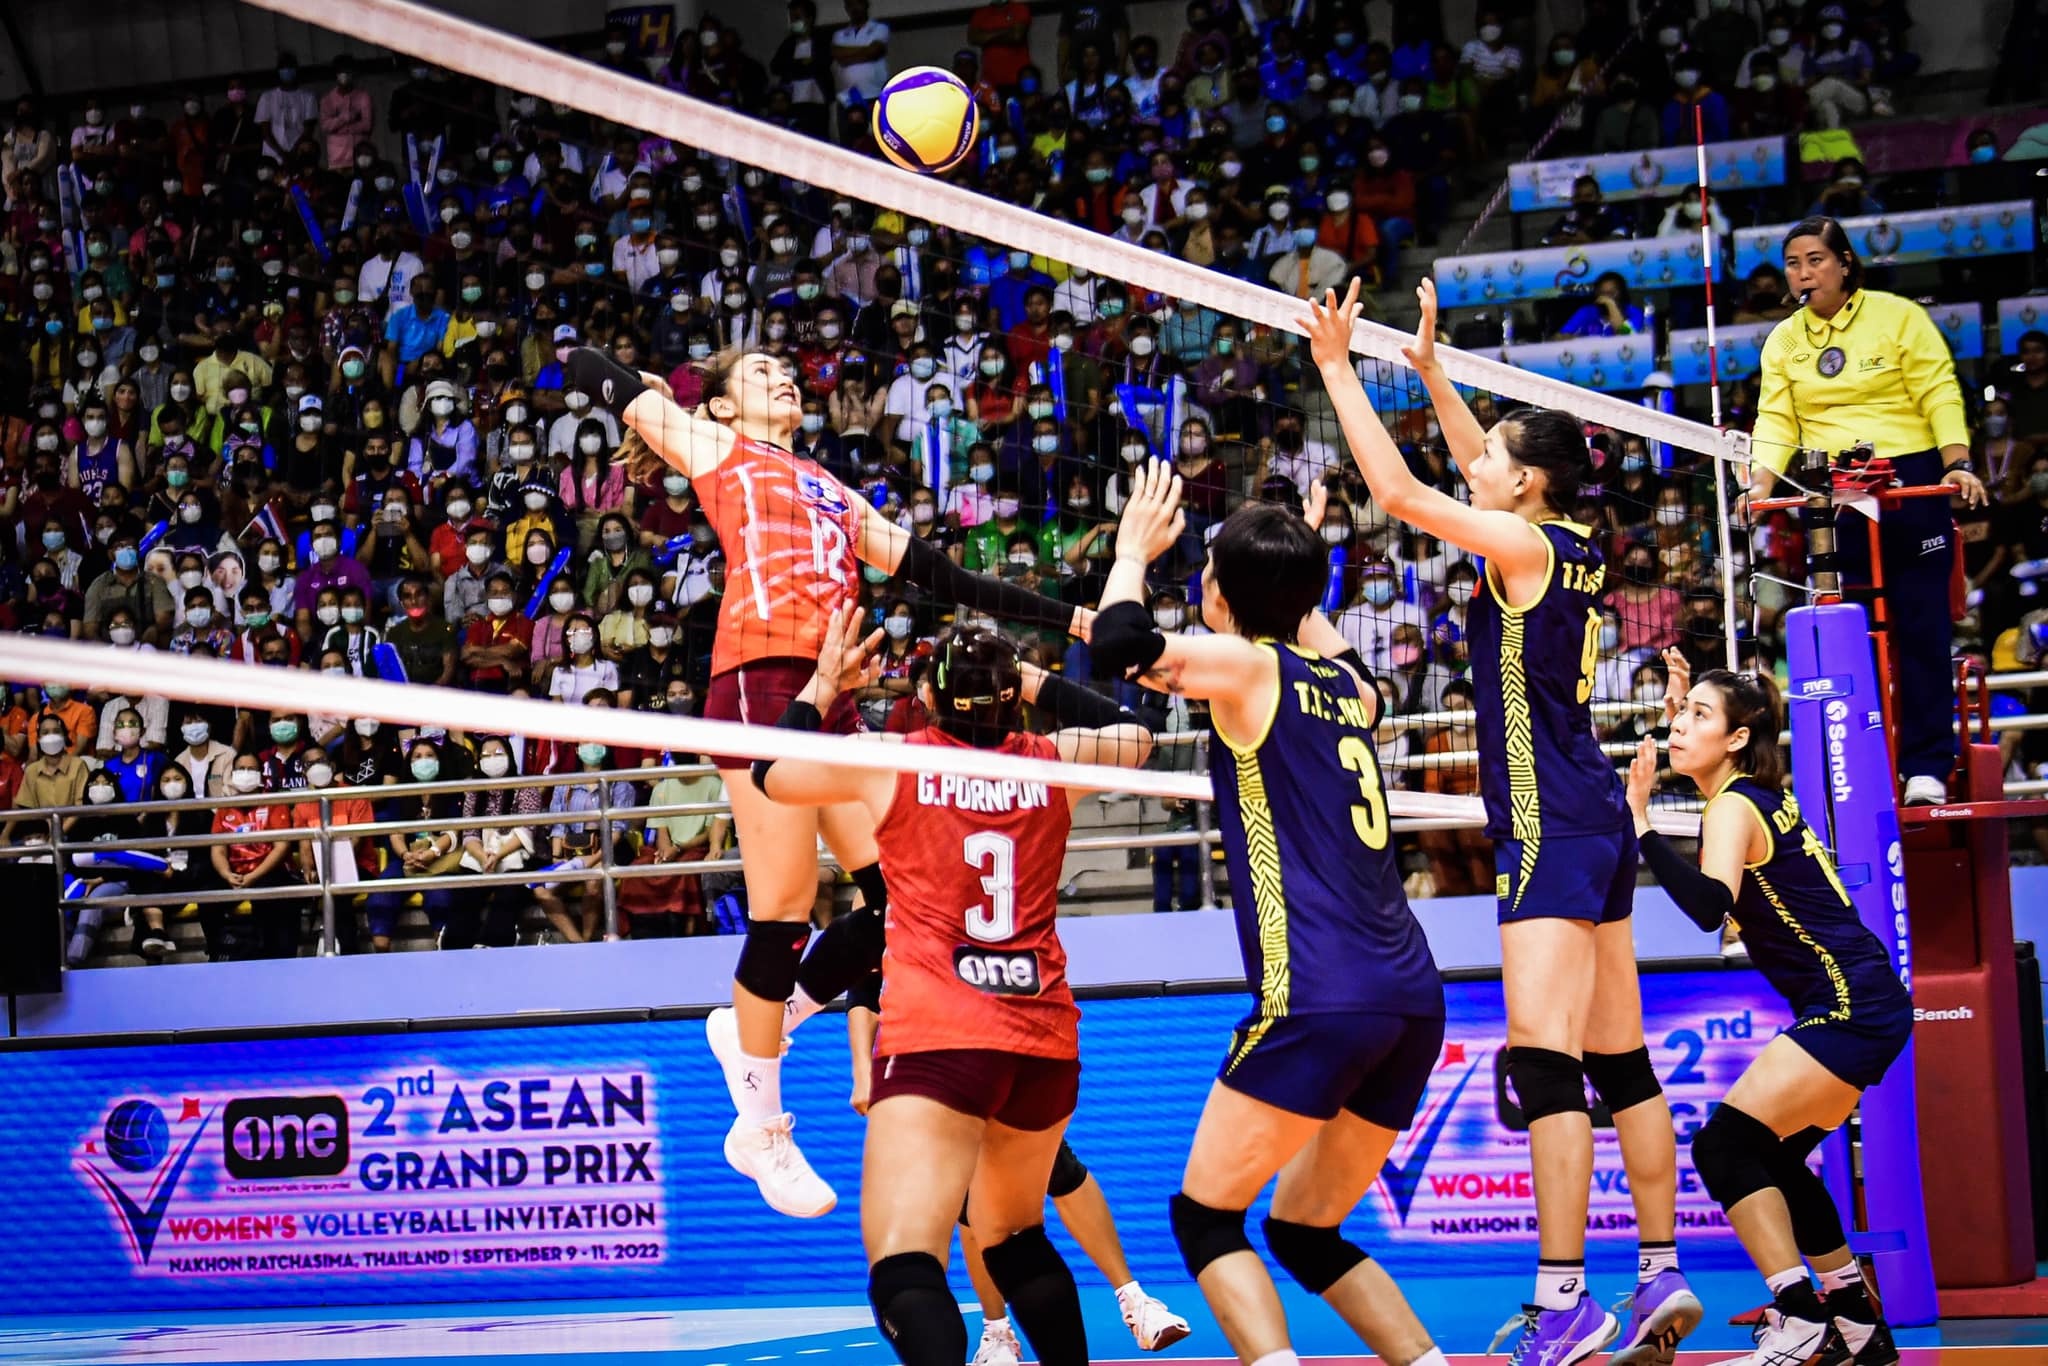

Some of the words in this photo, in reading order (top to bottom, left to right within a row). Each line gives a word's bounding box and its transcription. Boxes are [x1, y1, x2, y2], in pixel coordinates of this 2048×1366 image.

[807, 508, 848, 586] 12
[1829, 723, 1852, 802] Senoh
[1338, 736, 1390, 850] 3
[1940, 808, 1972, 817] Senoh
[964, 831, 1015, 942] 3
[1913, 1006, 1973, 1021] Senoh
[1664, 1010, 1752, 1085] 2nd
[362, 1070, 434, 1136] 2nd
[438, 1075, 645, 1134] ASEAN
[359, 1148, 528, 1191] GRAND
[543, 1142, 655, 1185] PRIX
[1429, 1172, 1532, 1199] WOME
[168, 1215, 297, 1242] WOMEN'S
[304, 1209, 477, 1237] VOLLEYBALL
[485, 1202, 656, 1231] INVITATION
[1431, 1217, 1519, 1234] NAKHON
[169, 1256, 242, 1273] NAKHON
[250, 1253, 359, 1271] RATCHASIMA,
[364, 1249, 450, 1267] THAILAND
[463, 1247, 562, 1264] SEPTEMBER
[568, 1246, 578, 1261] 9
[614, 1243, 659, 1260] 2022
